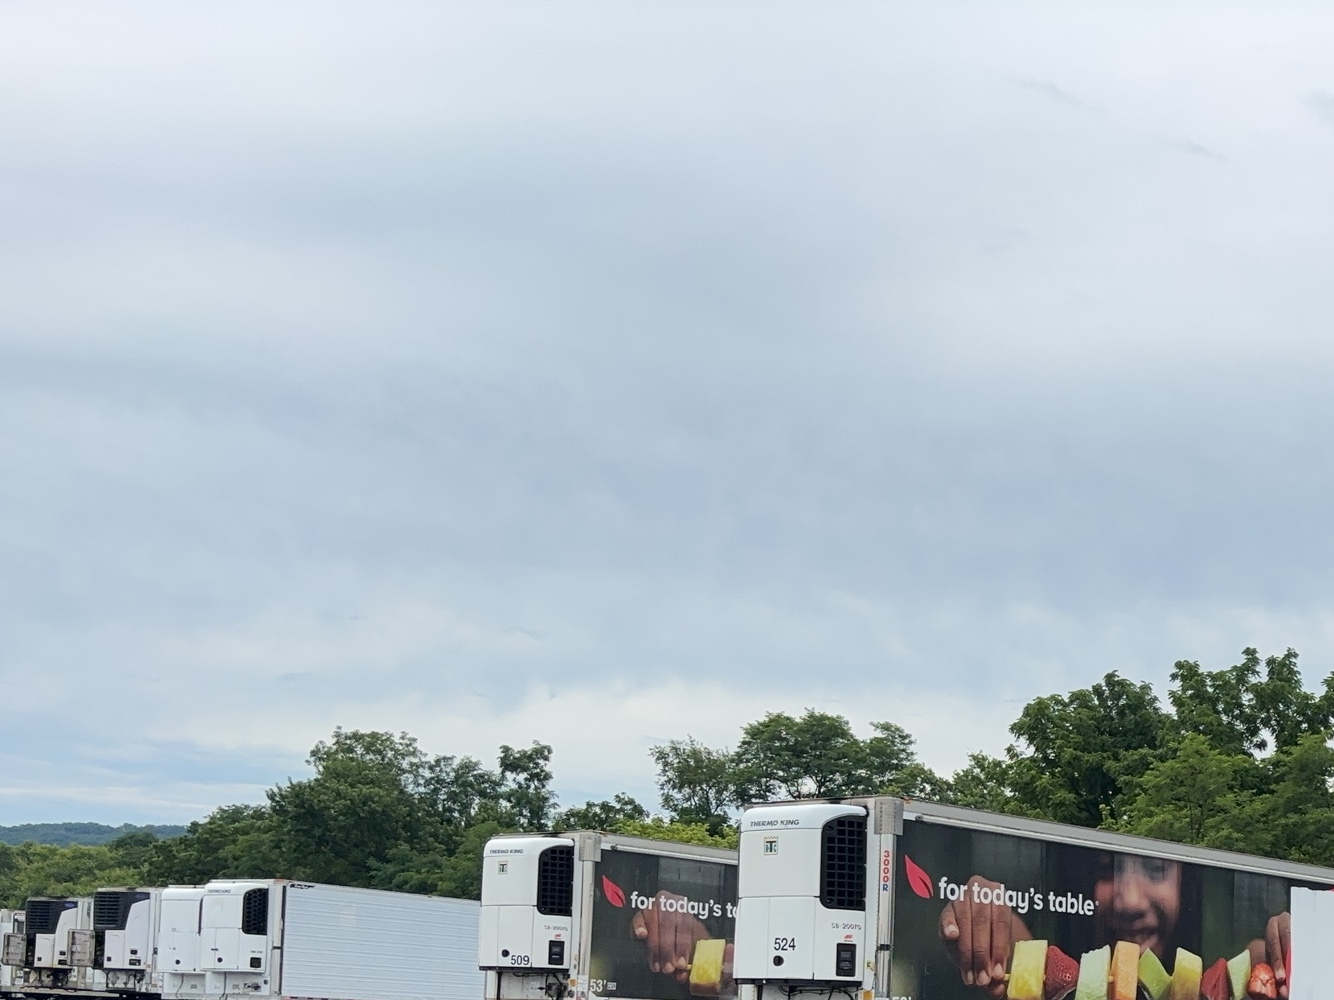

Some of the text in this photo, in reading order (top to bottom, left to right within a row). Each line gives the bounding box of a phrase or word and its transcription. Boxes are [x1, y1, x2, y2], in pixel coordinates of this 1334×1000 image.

[750, 820, 778, 828] THERMO
[882, 850, 890, 892] 3000R
[939, 876, 1095, 916] for today's table
[630, 891, 656, 910] for
[659, 895, 722, 919] today's
[774, 938, 796, 951] 524
[511, 955, 530, 965] 509
[590, 979, 607, 993] 53'
